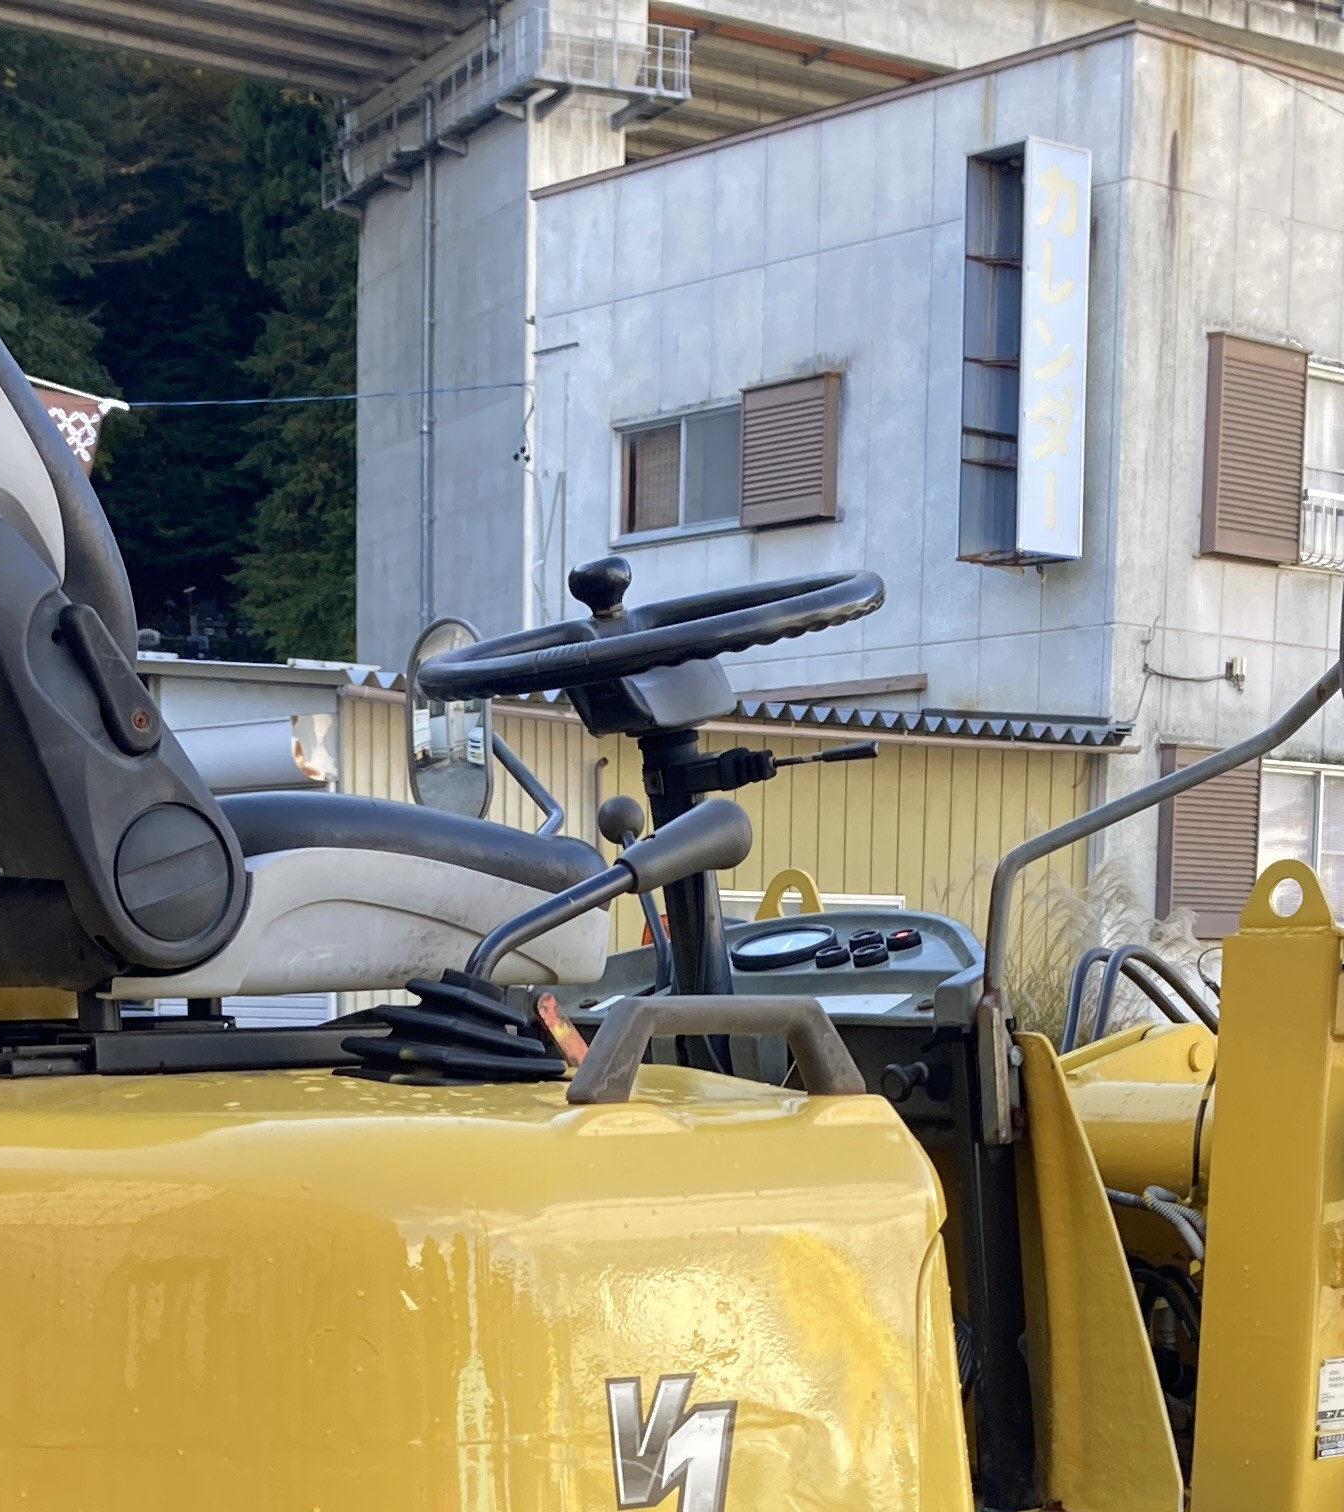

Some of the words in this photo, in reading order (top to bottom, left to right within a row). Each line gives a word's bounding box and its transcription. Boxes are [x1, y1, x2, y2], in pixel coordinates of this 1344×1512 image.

[1030, 162, 1079, 530] カレンダー
